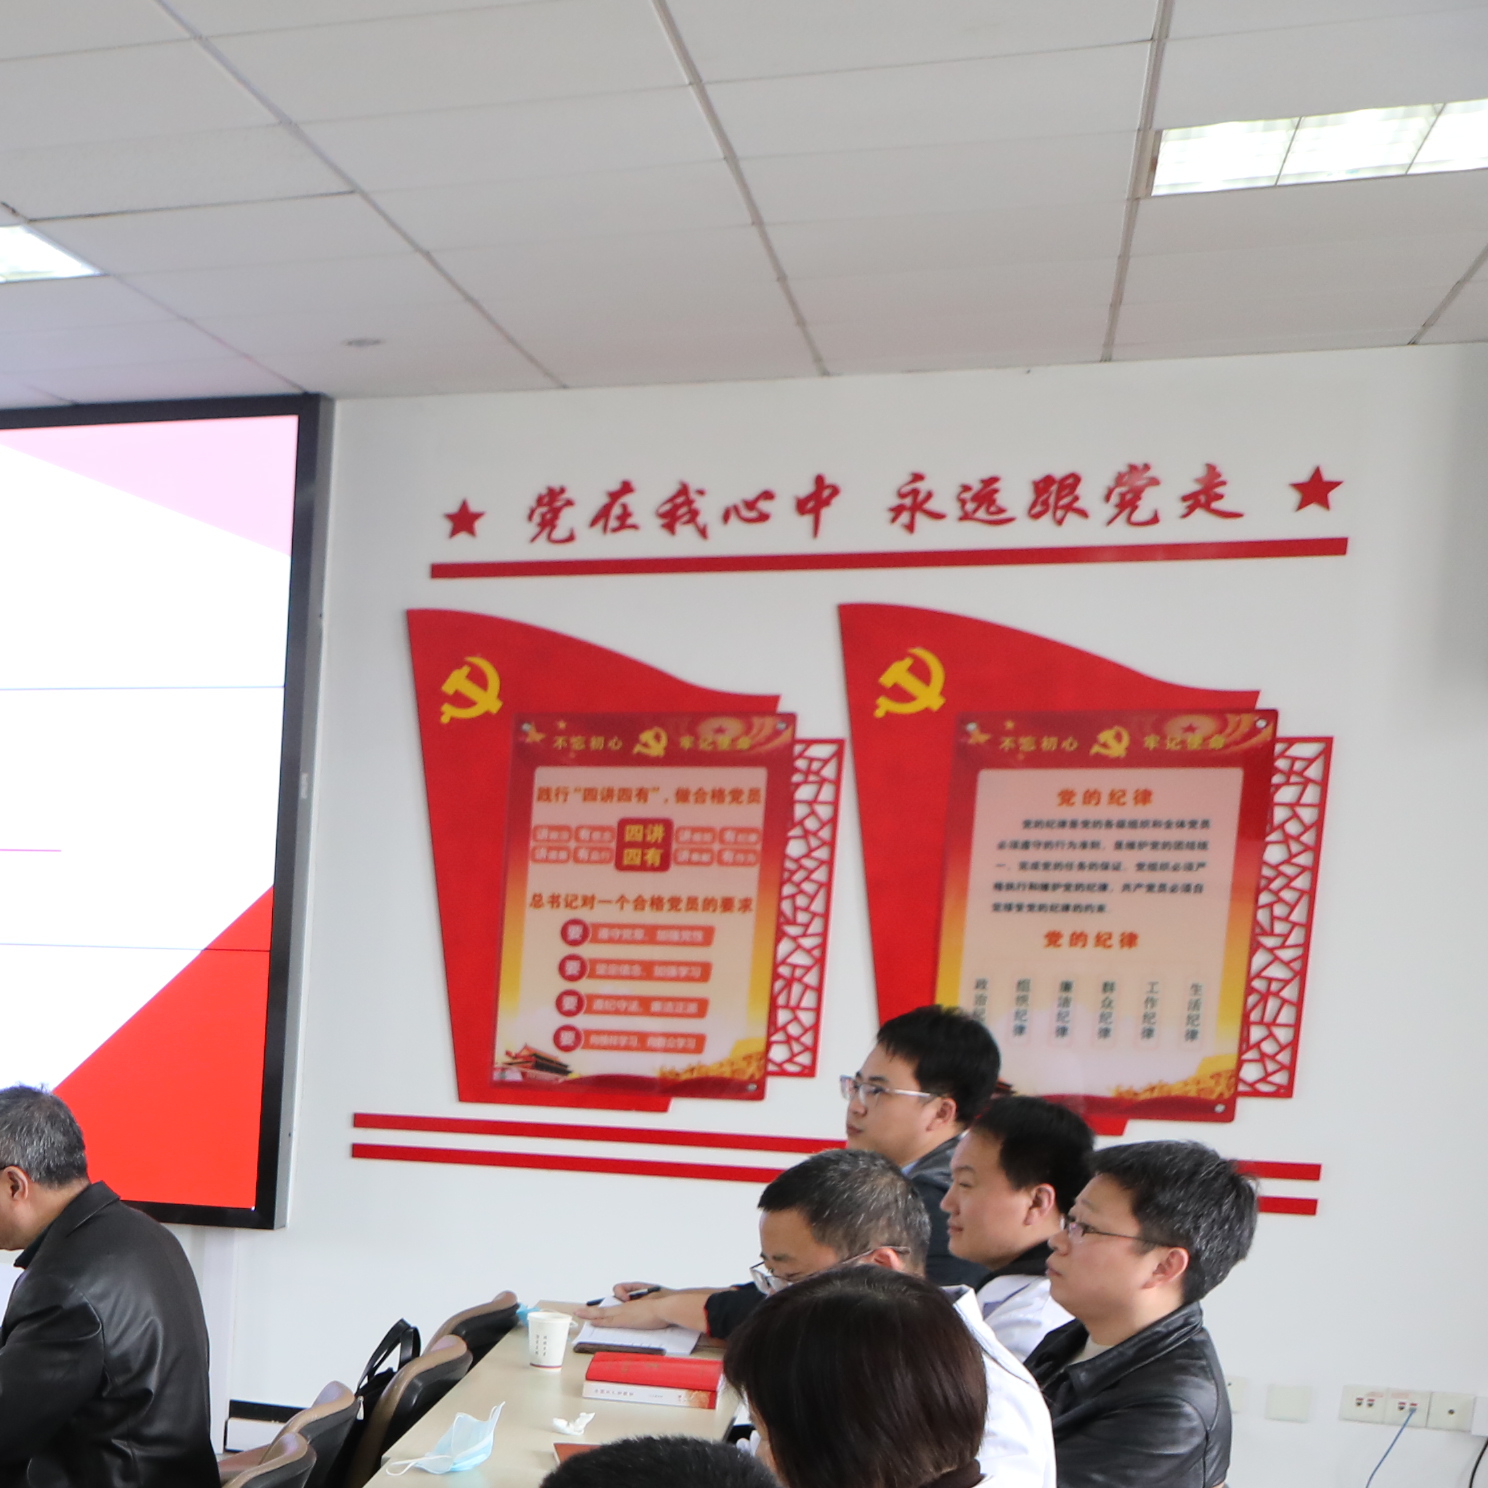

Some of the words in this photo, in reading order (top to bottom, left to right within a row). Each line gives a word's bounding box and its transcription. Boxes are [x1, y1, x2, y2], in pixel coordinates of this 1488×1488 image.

[529, 475, 839, 544] 党在我心中
[890, 464, 1243, 533] 永远跟党走
[552, 735, 623, 750] 不忘初心
[999, 735, 1079, 751] 不忘初心
[1144, 734, 1227, 750] 牢记使命
[1057, 788, 1154, 807] 党的纪律
[624, 824, 666, 843] 四讲
[623, 847, 664, 867] 四有
[529, 893, 754, 914] 总书记对一个合格党员的要求
[1044, 930, 1140, 949] 党的纪律
[973, 978, 989, 1023] 政治纪
[1013, 978, 1031, 1038] 组织纪律
[1055, 980, 1073, 1039] 廉洁纪律
[1097, 980, 1116, 1040] 群众纪律
[1140, 981, 1160, 1040] 工作纪律
[1184, 983, 1203, 1043] 生活纪律
